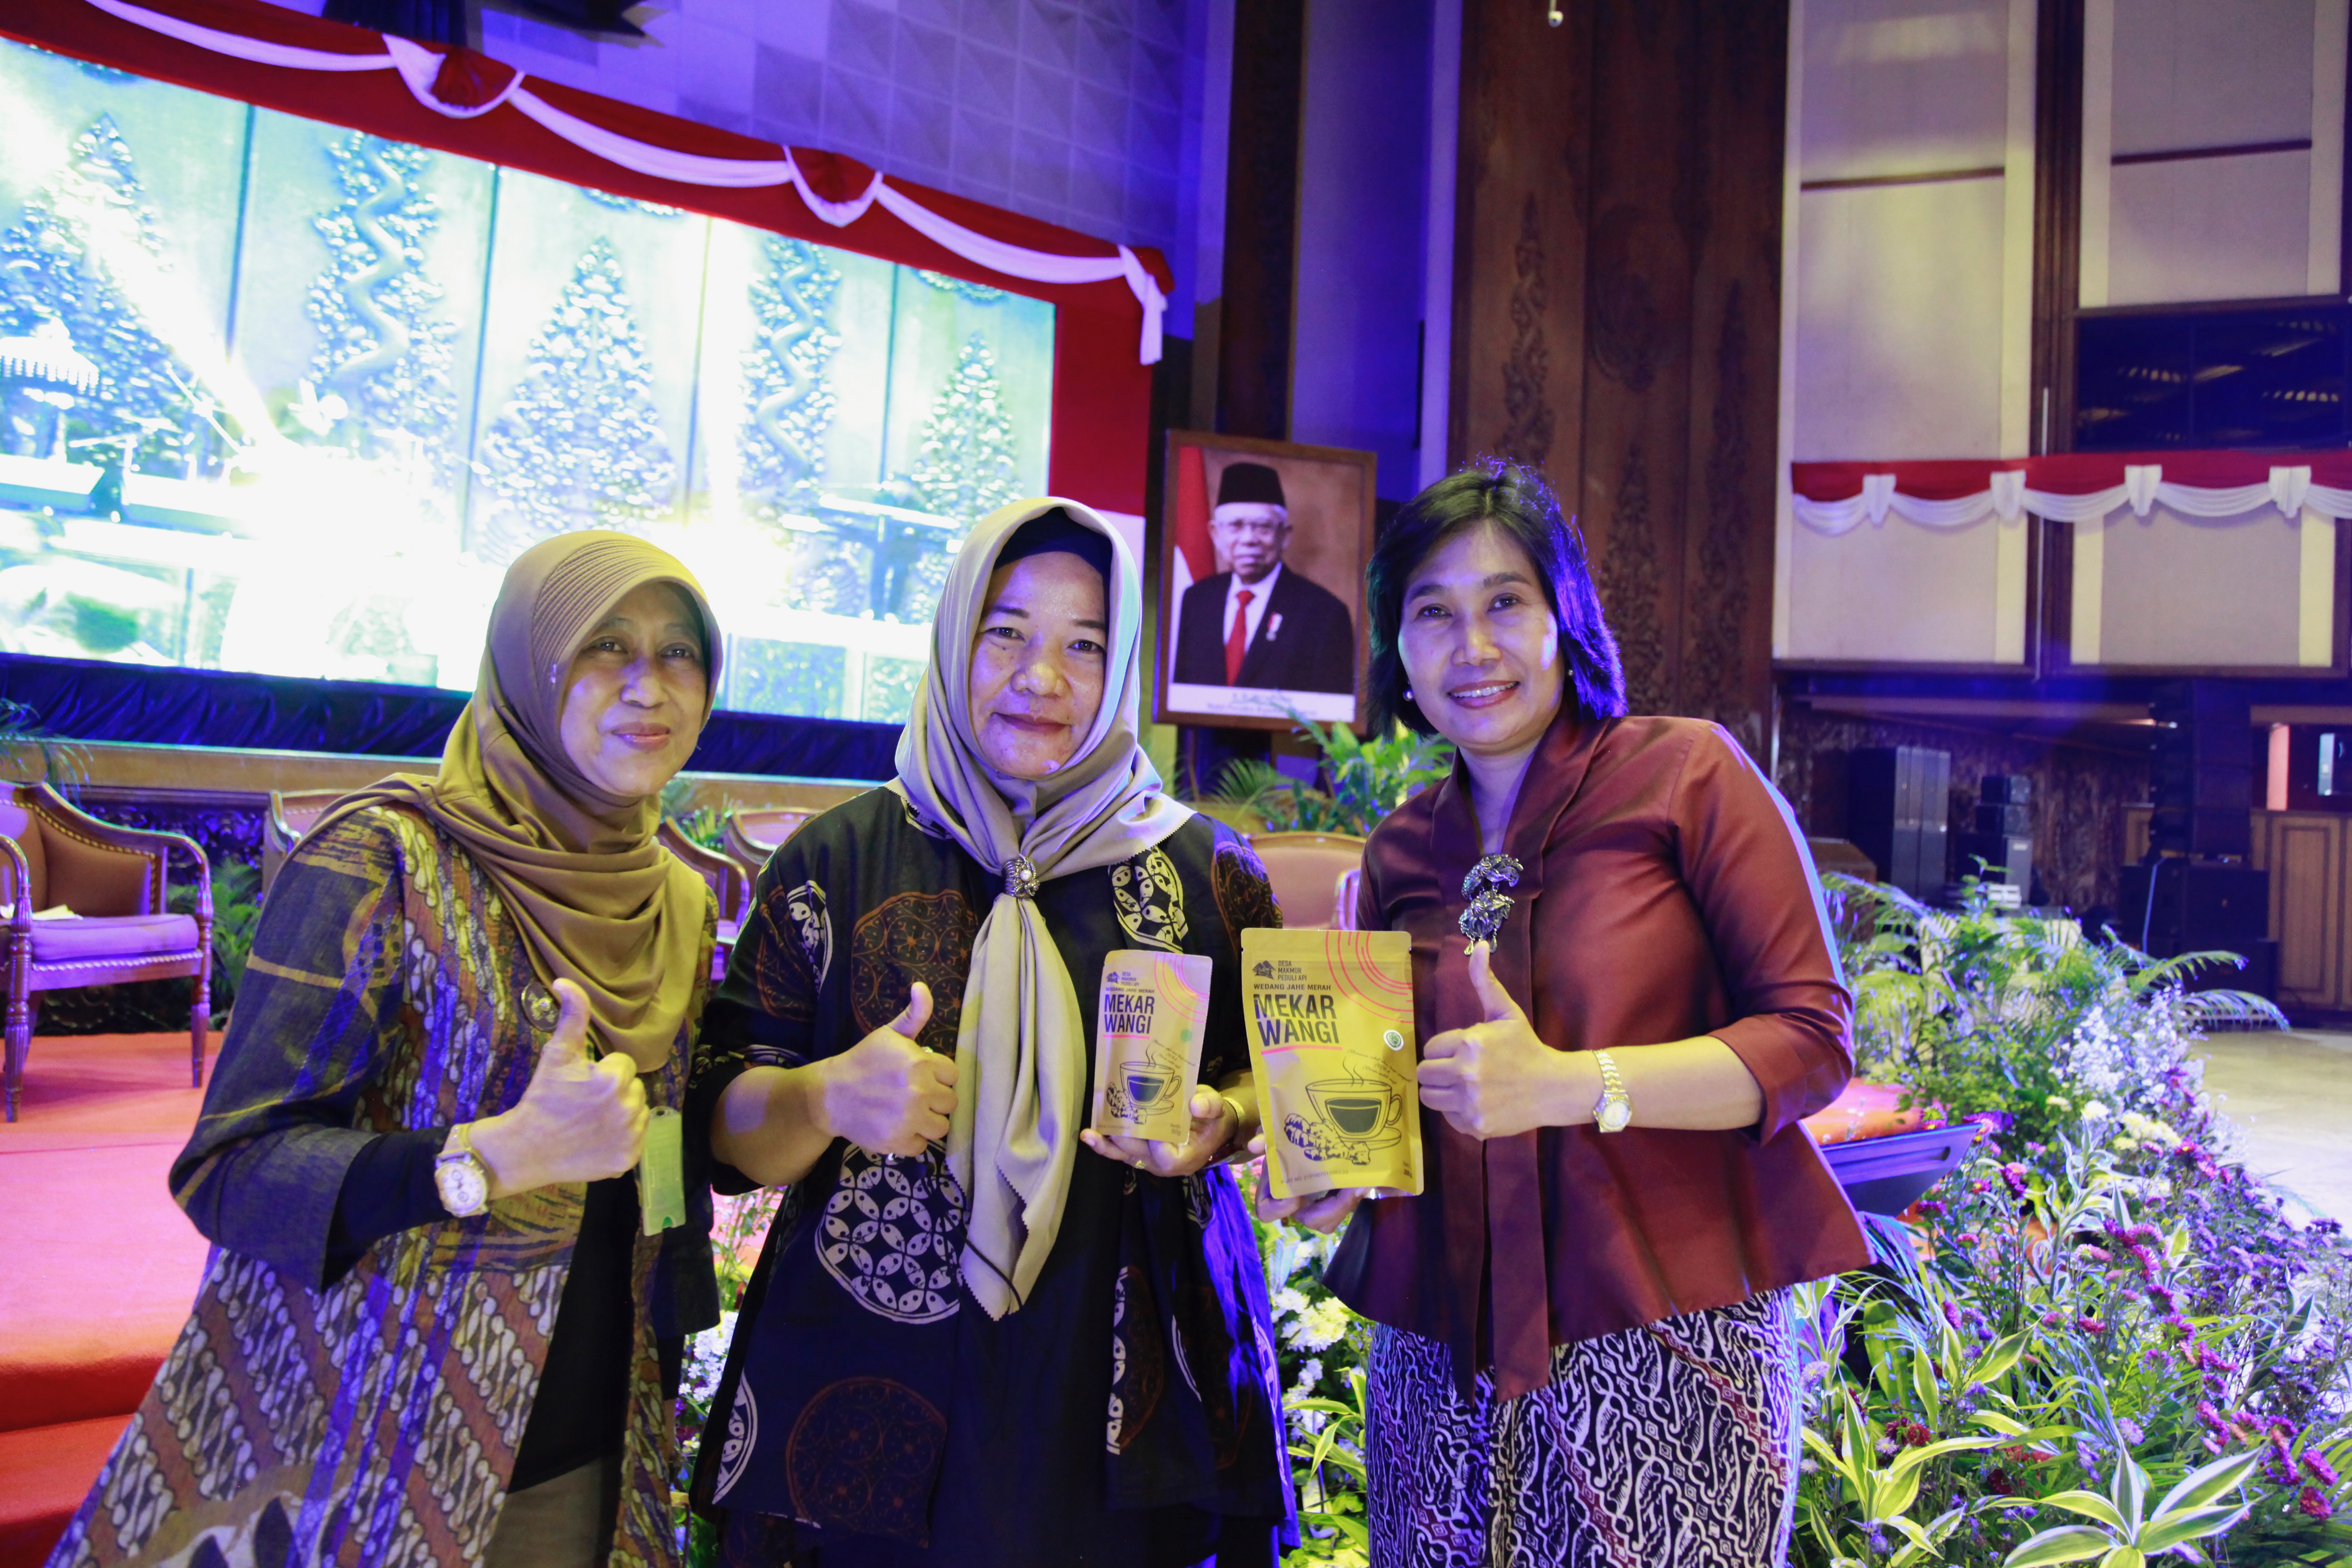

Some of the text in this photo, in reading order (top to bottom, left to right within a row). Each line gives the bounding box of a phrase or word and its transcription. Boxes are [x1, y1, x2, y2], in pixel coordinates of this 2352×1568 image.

[1104, 994, 1155, 1015] MEKAR
[1253, 994, 1337, 1019] MEKAR
[1104, 1014, 1151, 1034] WANGI
[1257, 1019, 1340, 1047] WANGI
